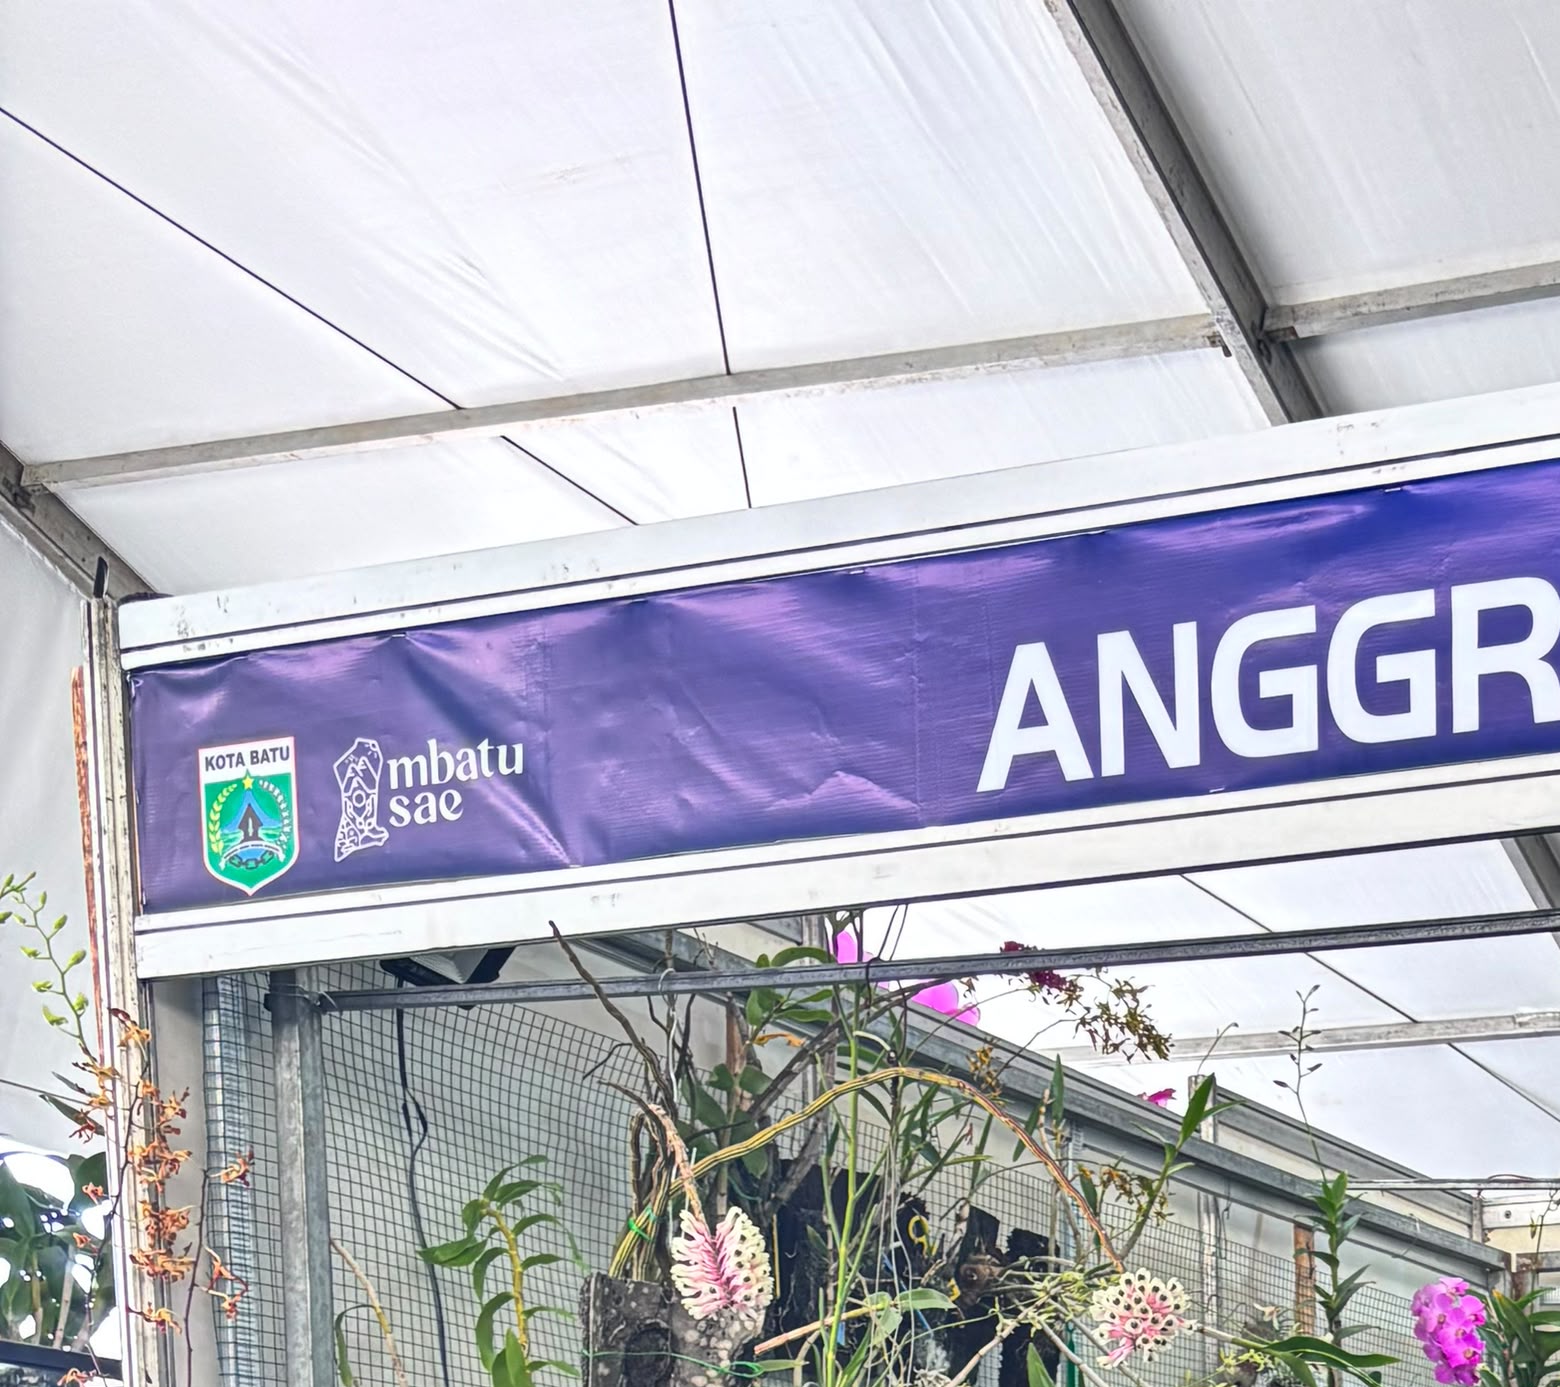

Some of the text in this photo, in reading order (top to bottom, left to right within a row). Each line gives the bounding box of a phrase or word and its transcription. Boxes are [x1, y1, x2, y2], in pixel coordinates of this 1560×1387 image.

[204, 745, 291, 772] KOTA BATU
[387, 738, 524, 790] mbatu
[389, 789, 464, 828] sae
